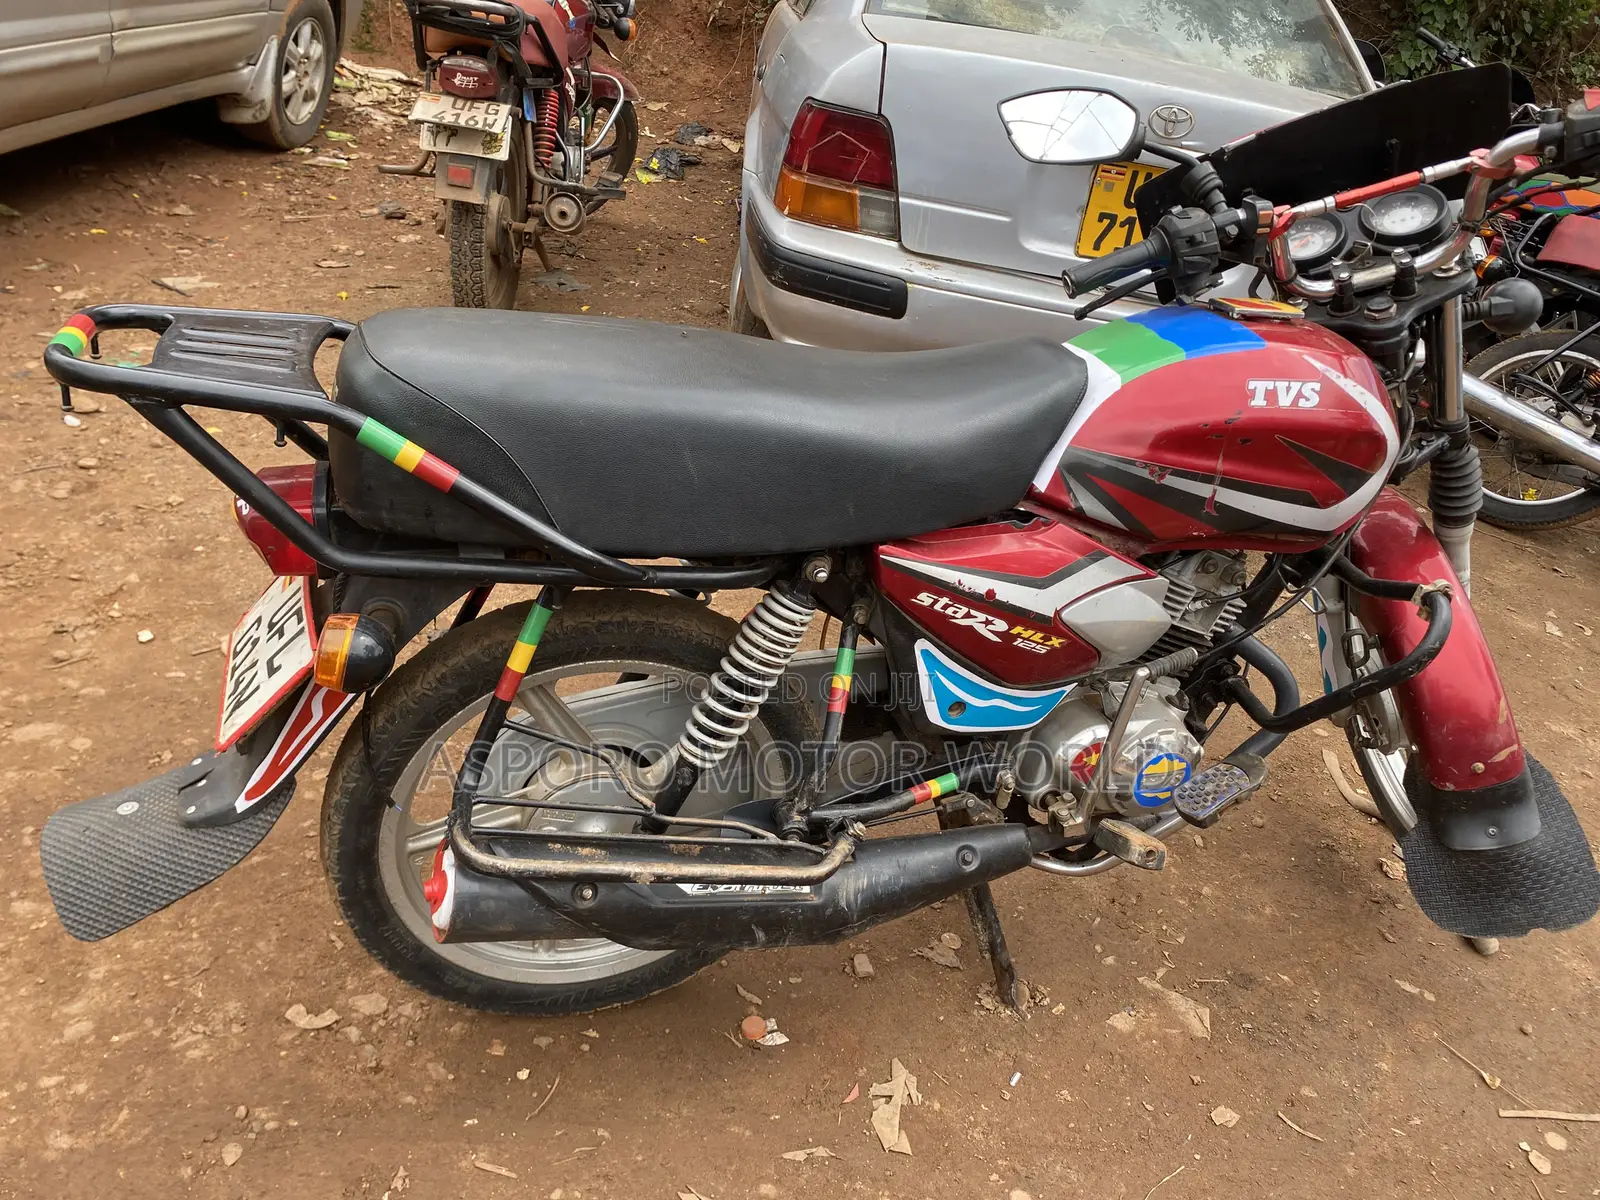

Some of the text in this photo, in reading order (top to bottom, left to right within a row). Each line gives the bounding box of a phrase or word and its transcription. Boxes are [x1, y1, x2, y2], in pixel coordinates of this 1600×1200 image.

[451, 97, 501, 116] UFG
[431, 110, 498, 130] 416W
[1247, 380, 1321, 408] TVS
[1009, 625, 1067, 648] HLX
[1012, 637, 1052, 654] 125
